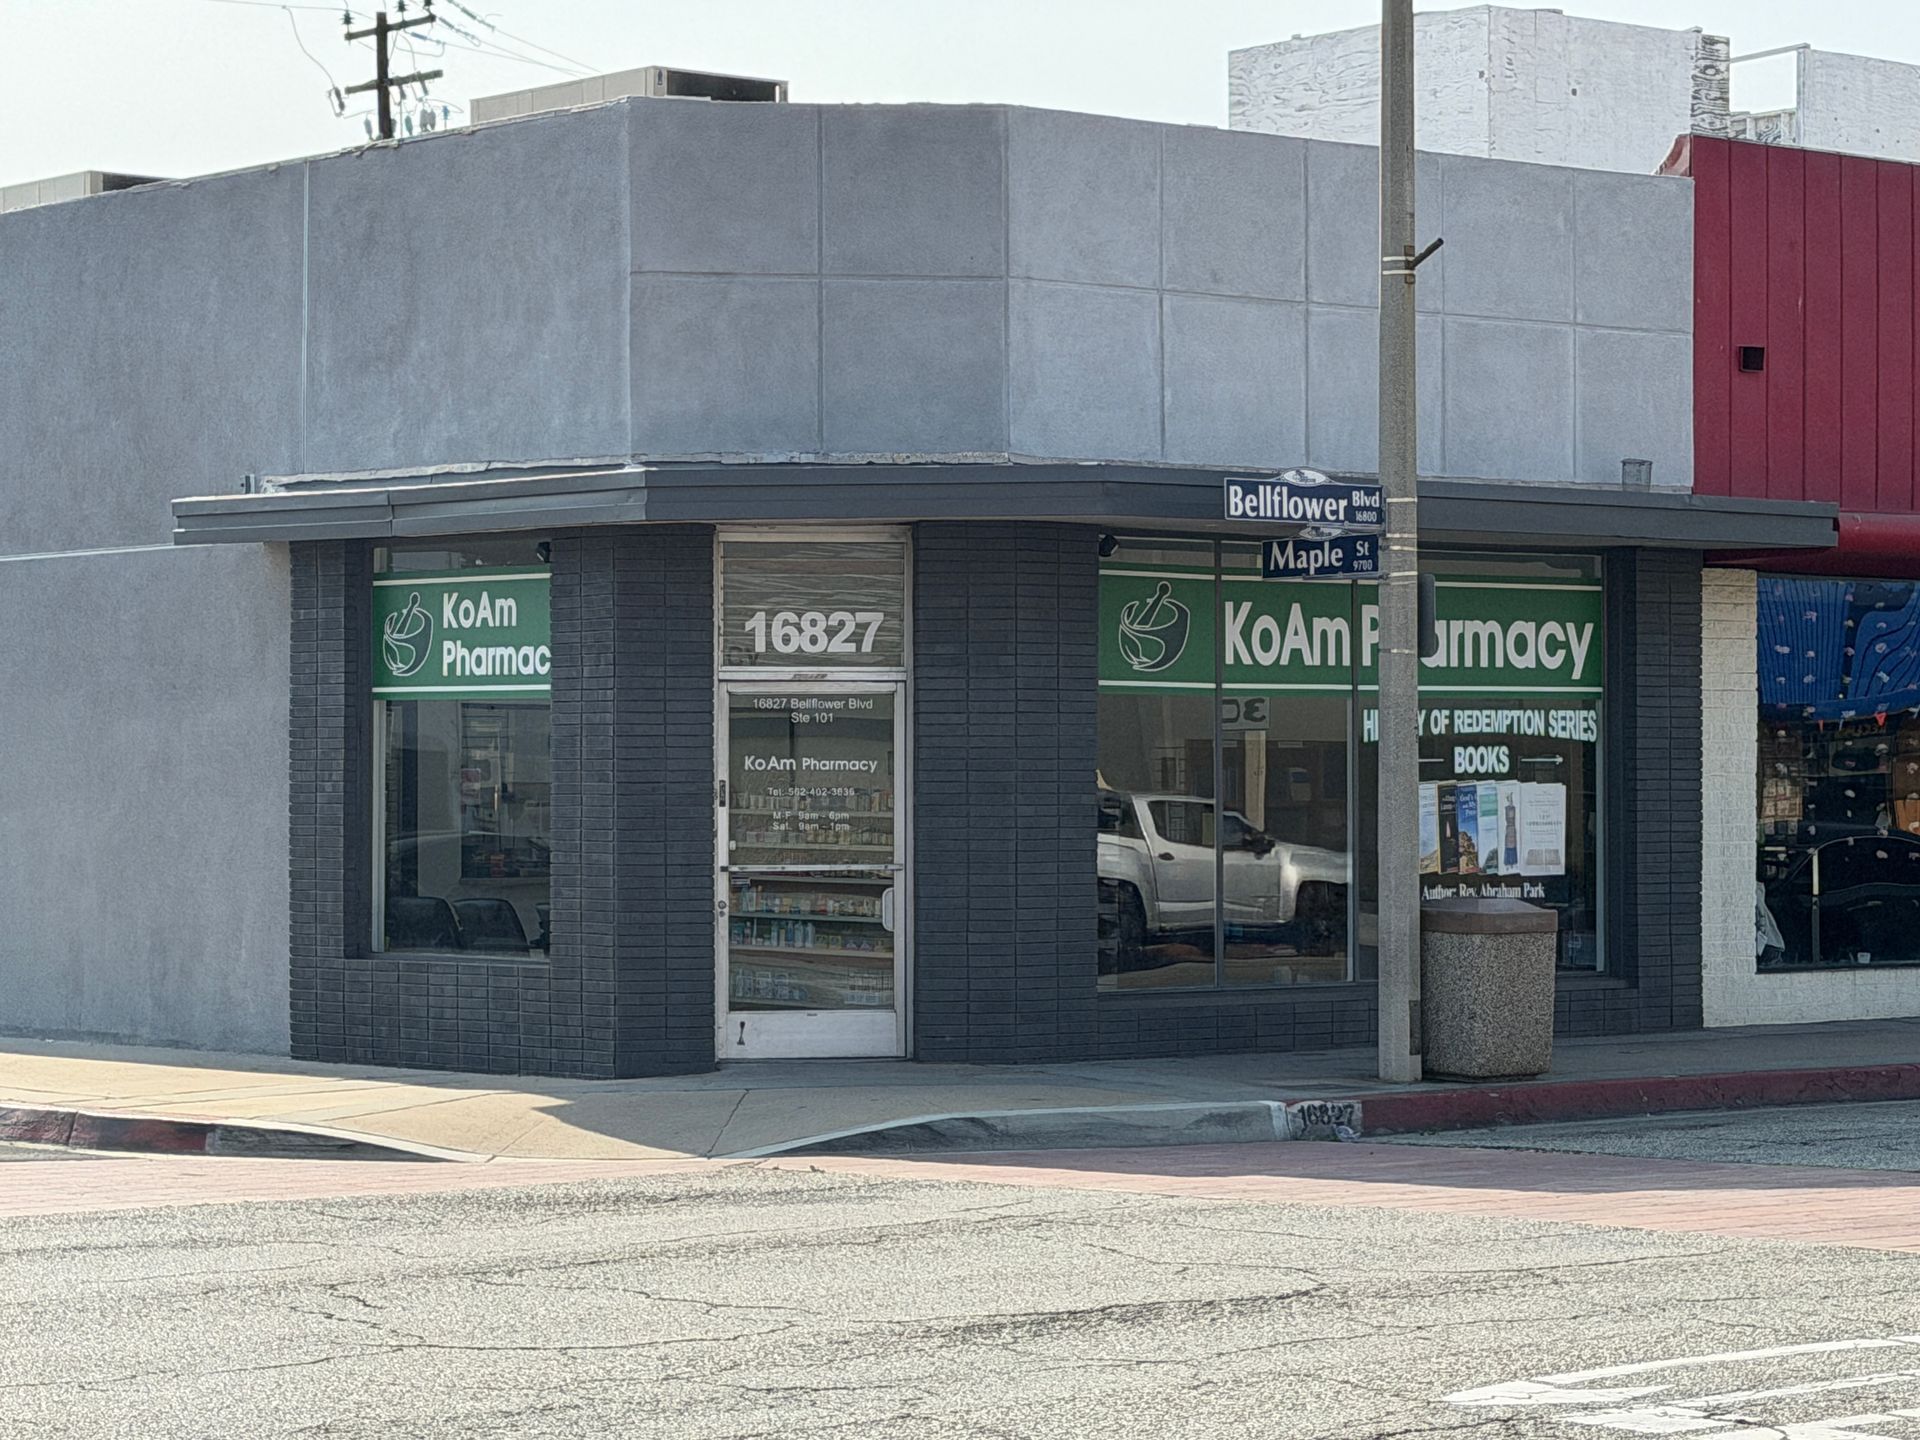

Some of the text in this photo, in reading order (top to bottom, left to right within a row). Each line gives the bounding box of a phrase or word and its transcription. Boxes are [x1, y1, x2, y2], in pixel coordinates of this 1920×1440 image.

[1229, 485, 1380, 521] Bellflower Blvd
[1355, 511, 1377, 522] 16800
[1270, 541, 1369, 576] Maple St
[1353, 560, 1372, 571] 9700
[443, 591, 517, 629] KoAm
[744, 611, 884, 653] 16827
[1225, 601, 1594, 680] KoAm Parmacy
[753, 698, 873, 709] 16827 Bellflower Blvd
[791, 712, 834, 723] Ste 101
[1430, 710, 1450, 735] OF
[1454, 710, 1545, 737] REDEMPTION
[1549, 709, 1597, 742] SERIES
[744, 756, 877, 773] KoAm Pharmacy
[1454, 746, 1510, 774] BOOKS
[1422, 881, 1546, 901] Author: Rev. Abraham Park
